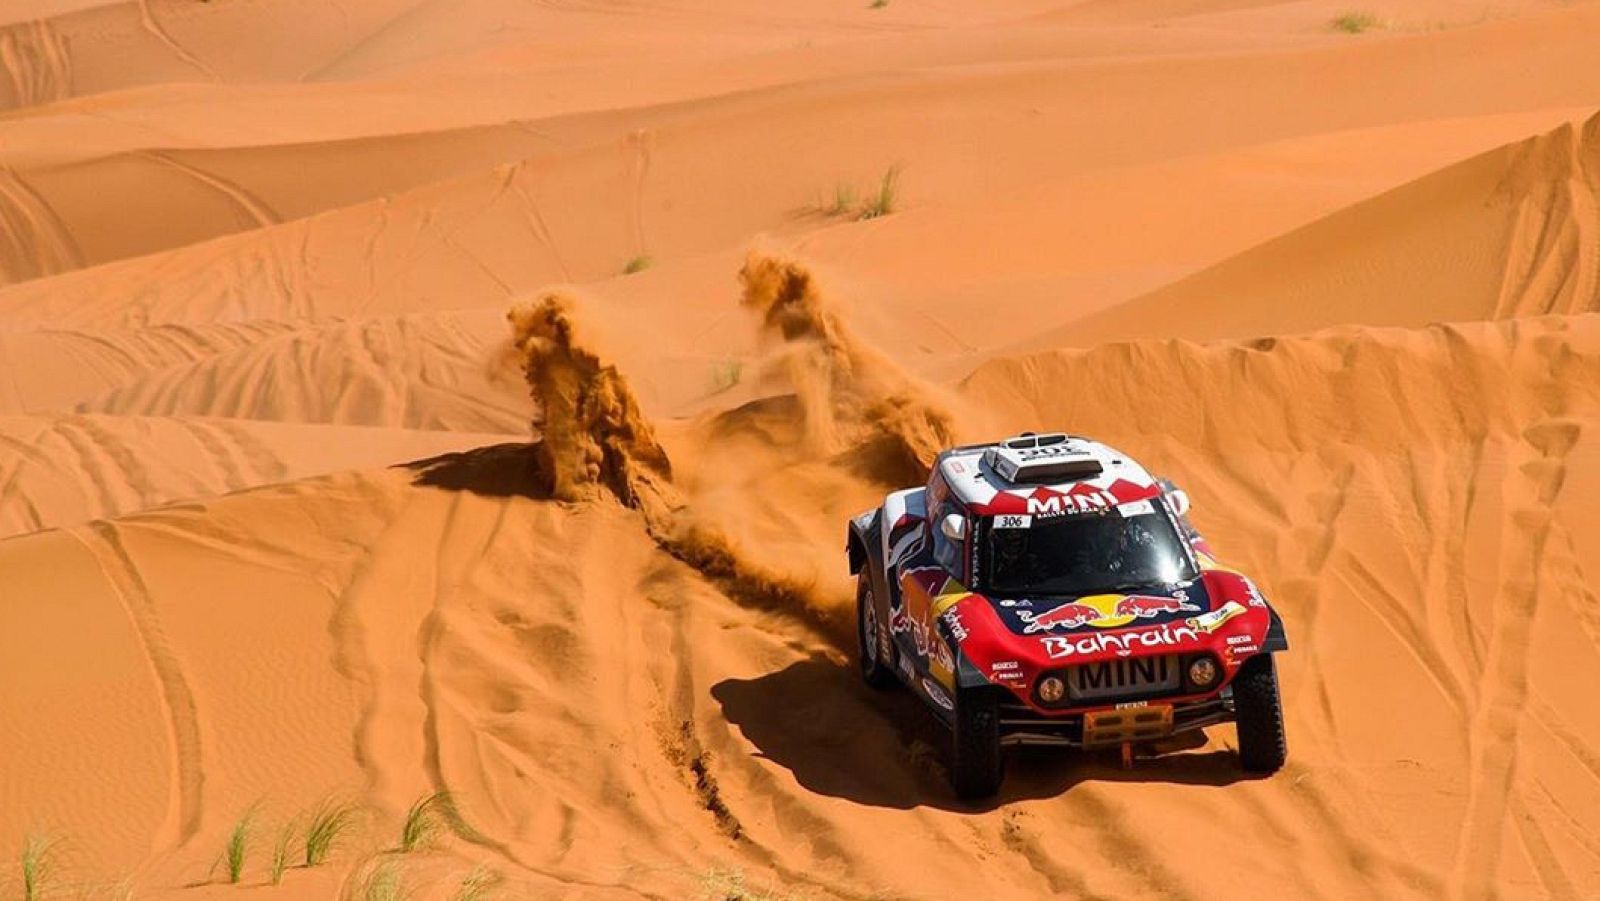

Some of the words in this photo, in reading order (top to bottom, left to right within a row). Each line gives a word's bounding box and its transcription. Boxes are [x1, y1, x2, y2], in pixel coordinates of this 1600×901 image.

[1027, 489, 1119, 514] MINI
[1001, 515, 1023, 527] 306
[943, 605, 969, 642] Bahrain
[1040, 623, 1199, 659] Bahrain
[1078, 654, 1170, 691] MINI
